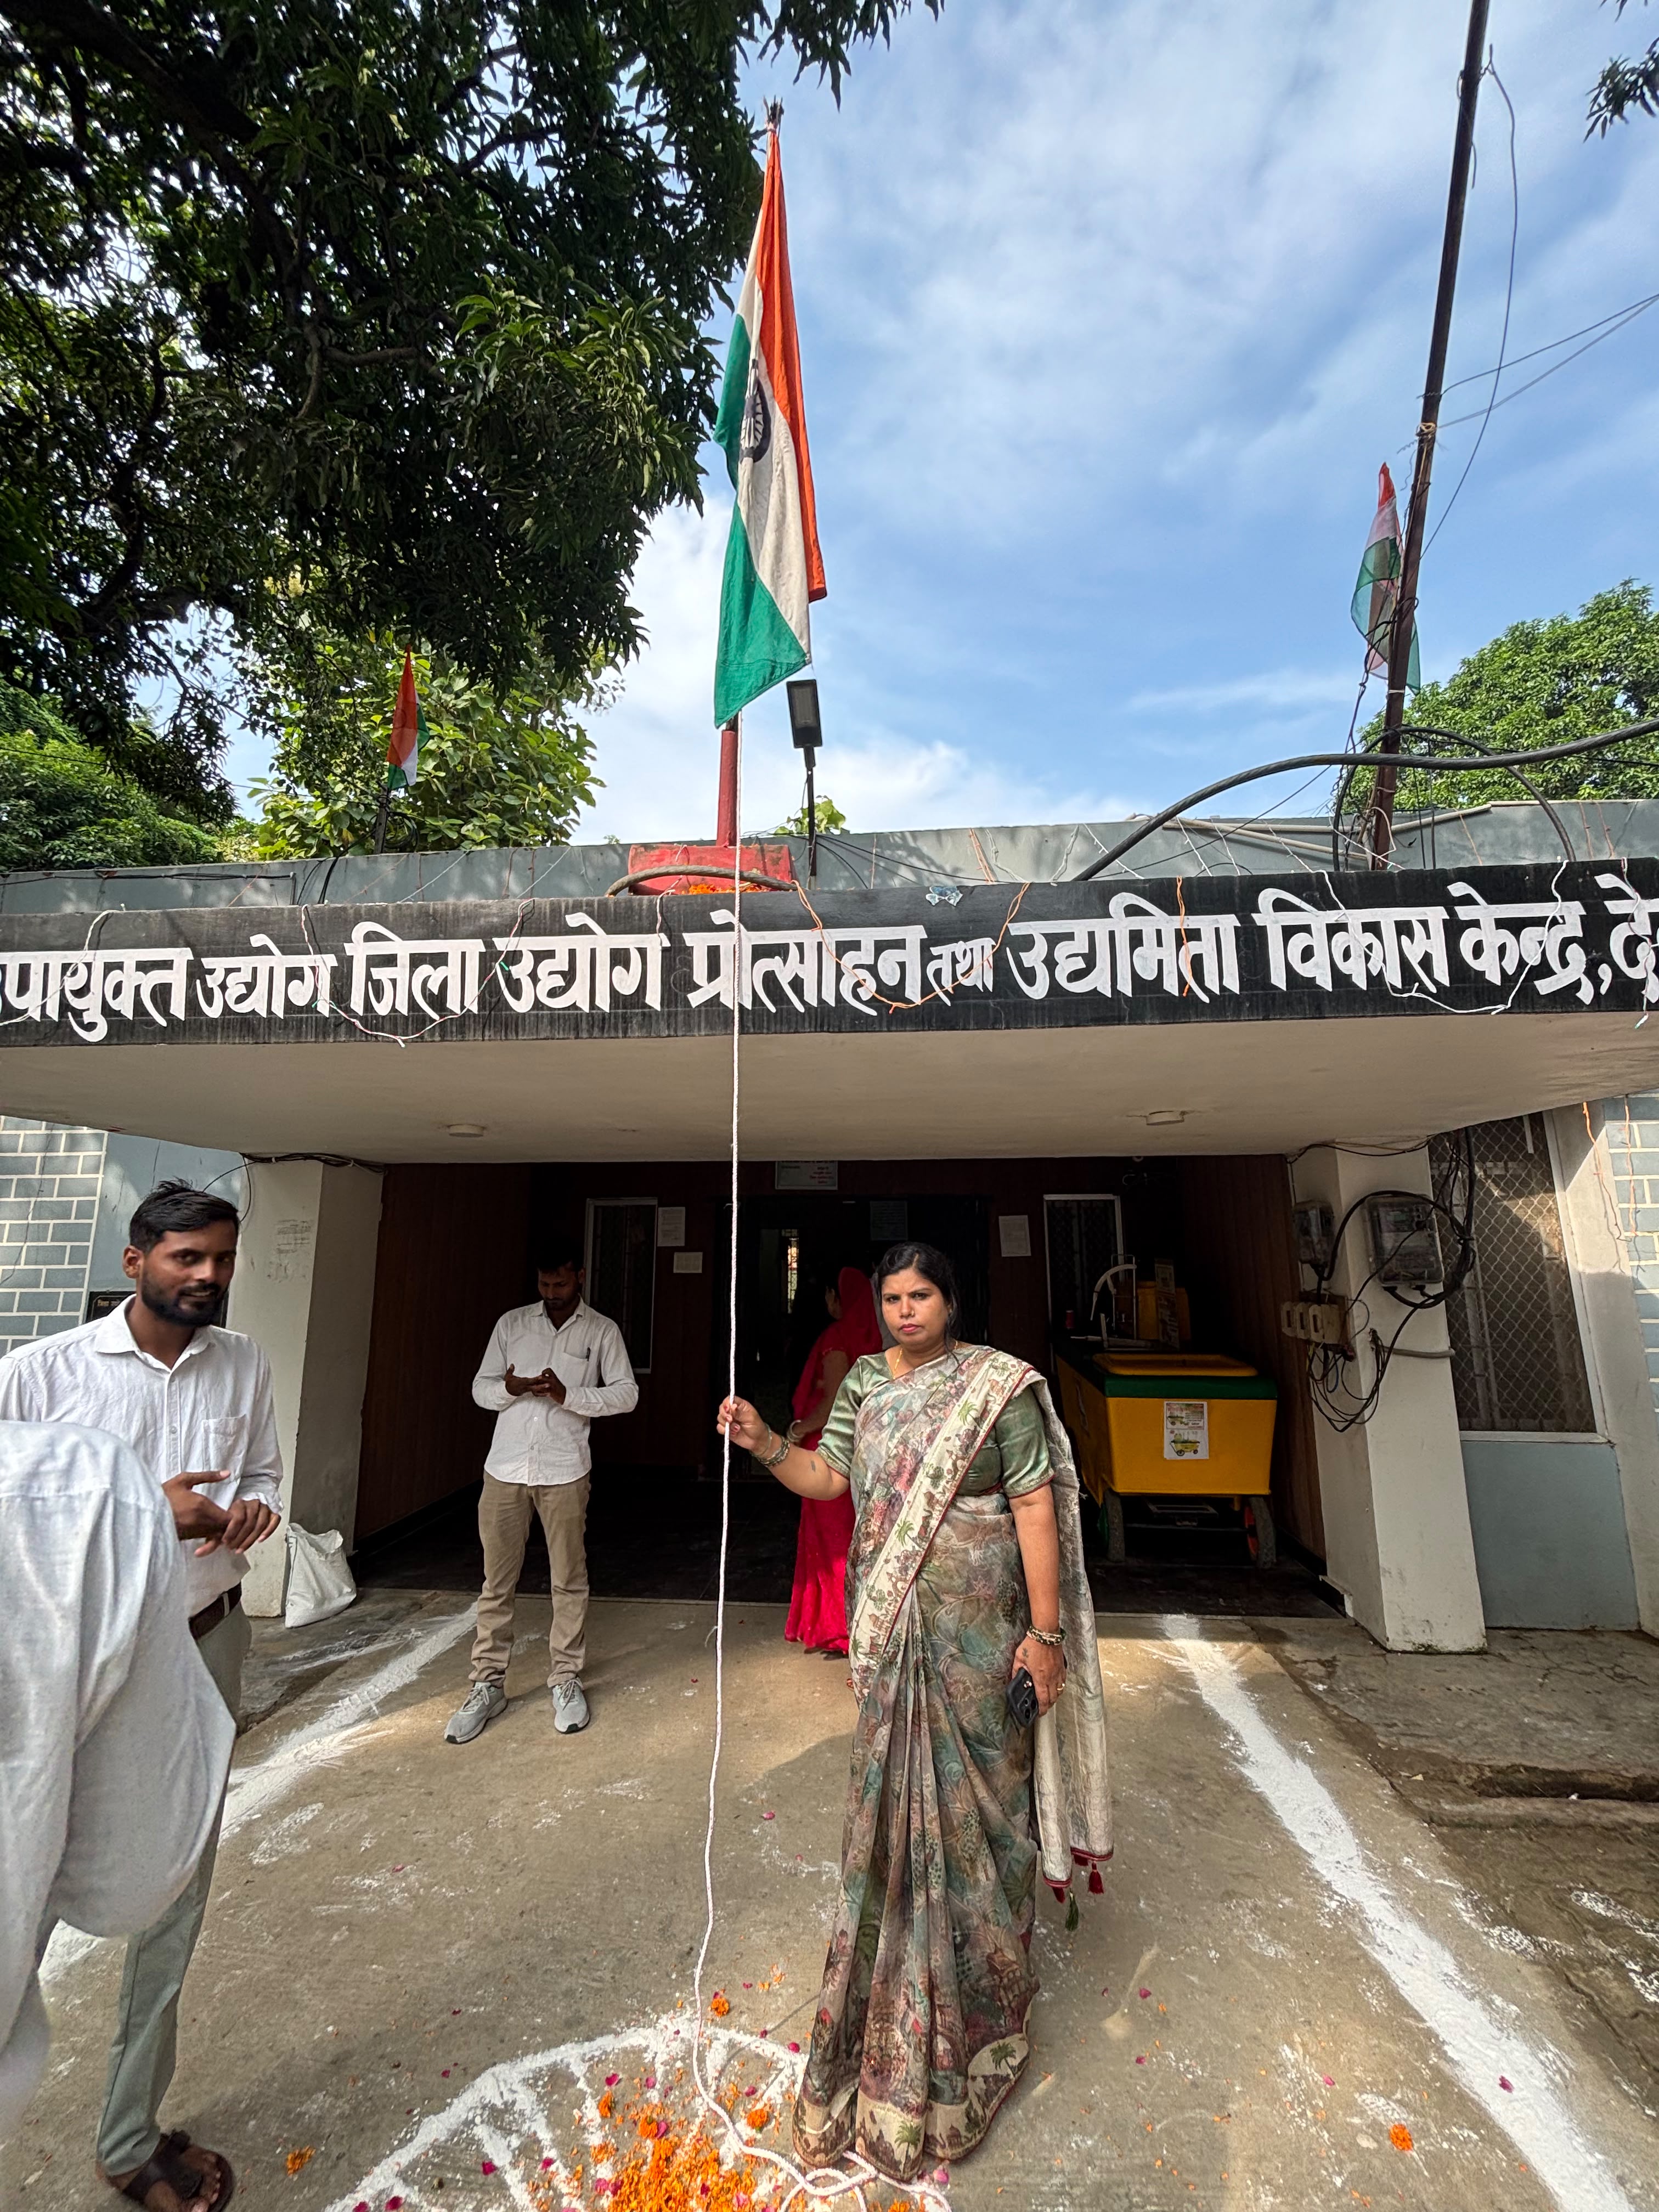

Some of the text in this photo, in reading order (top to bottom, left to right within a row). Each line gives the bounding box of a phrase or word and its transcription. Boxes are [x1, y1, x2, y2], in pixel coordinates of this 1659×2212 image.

[0, 873, 1659, 1042] पायुक्त उद्योग जिला उद्योग प्रोत्साहन तथा उद्यमिता विकास केन्द्र, दे
